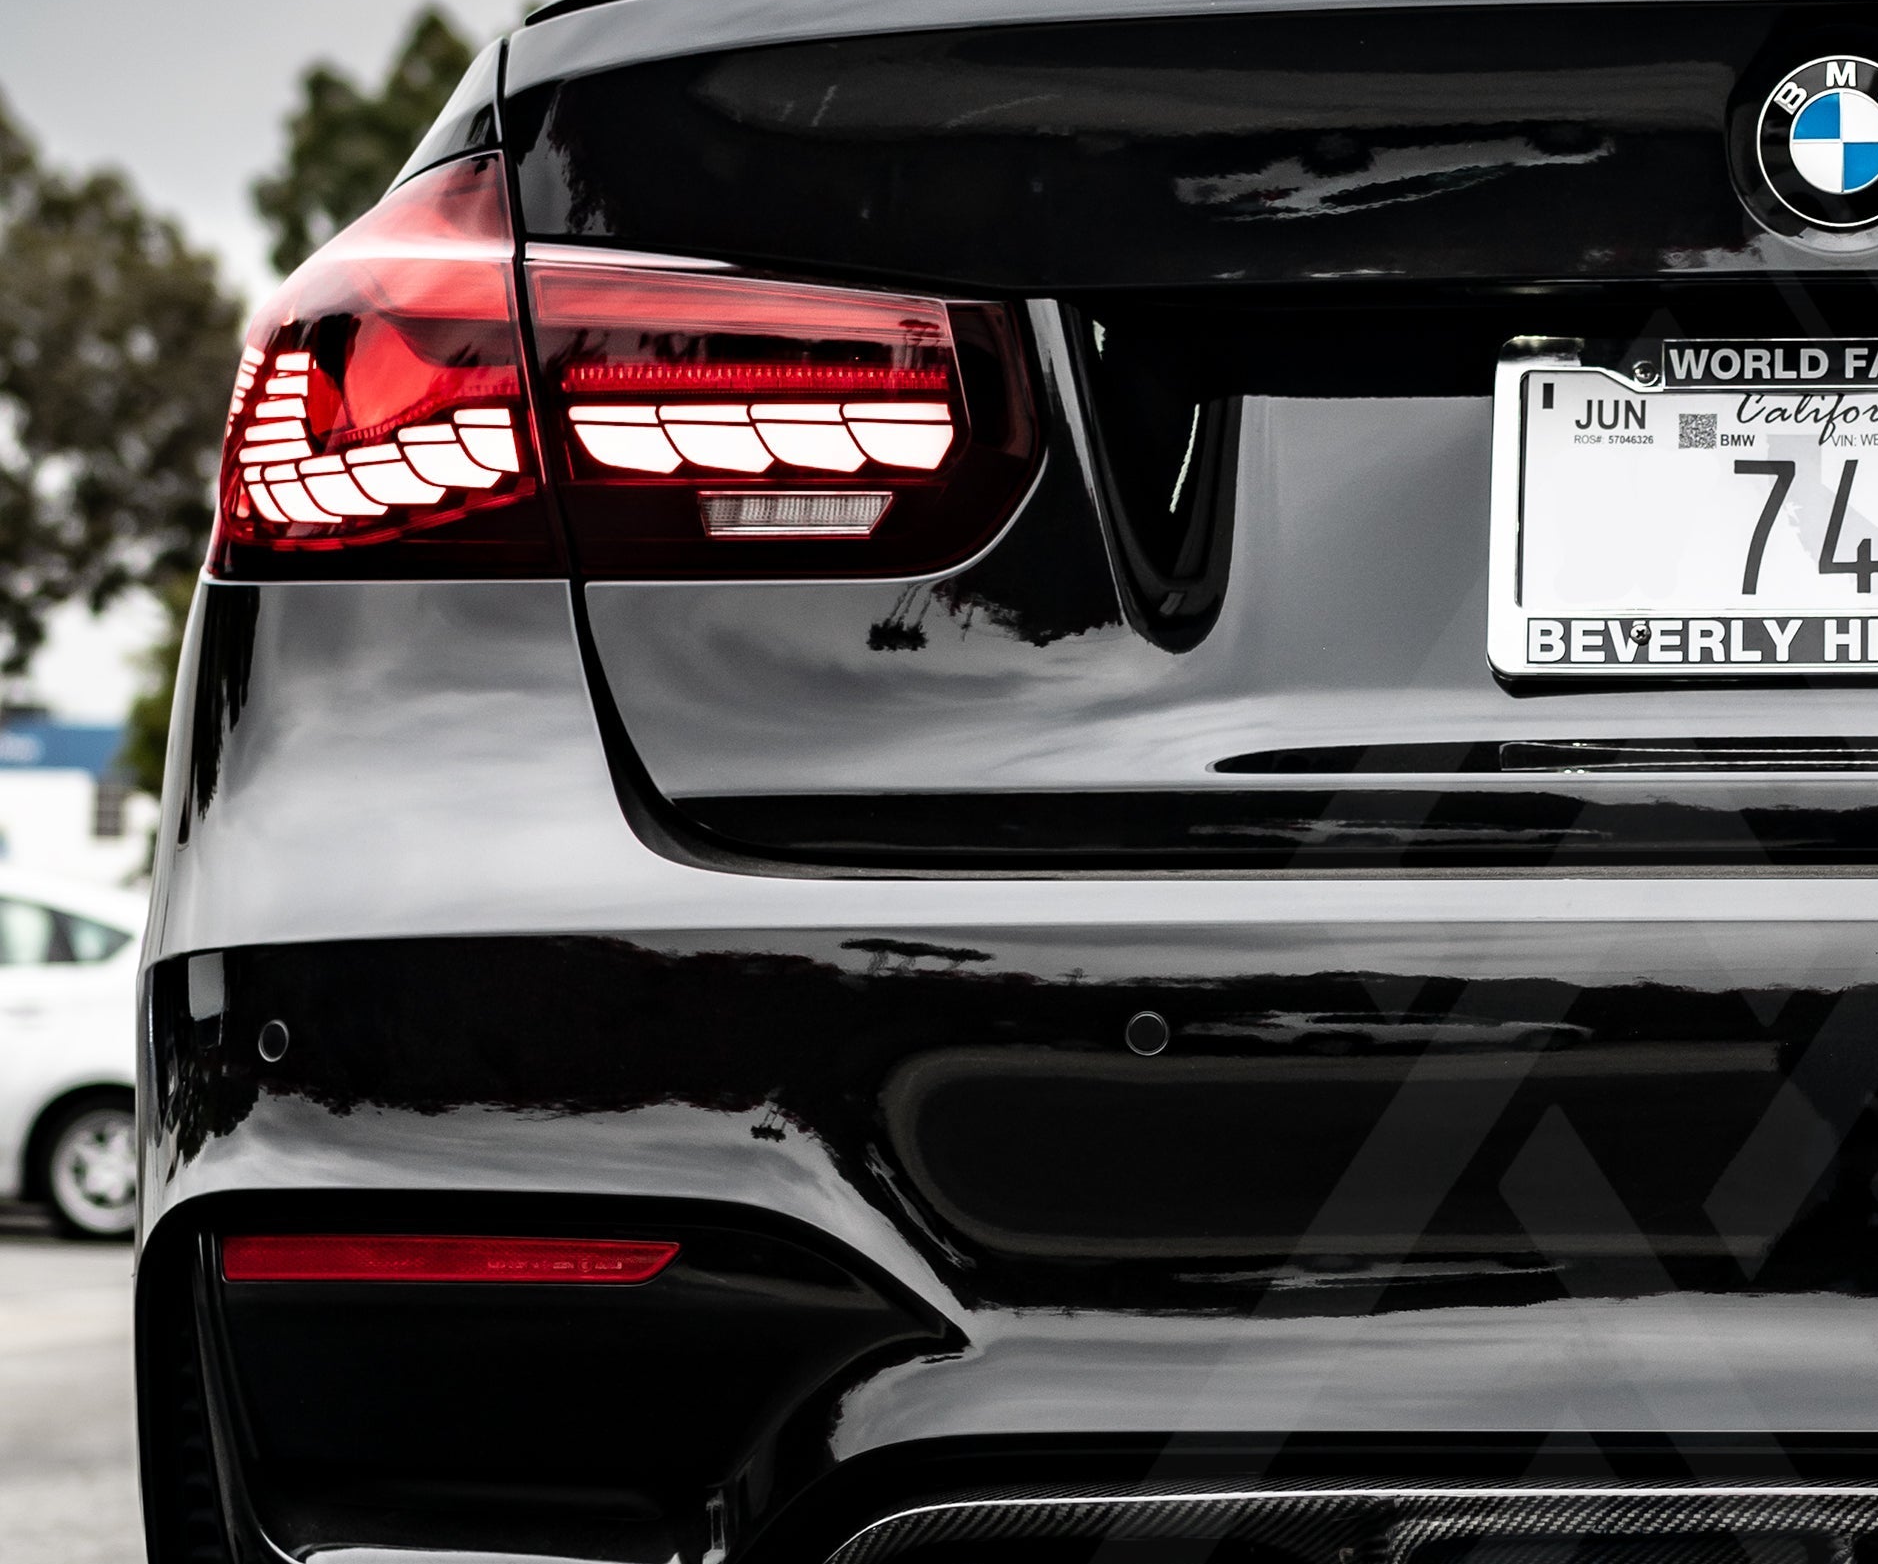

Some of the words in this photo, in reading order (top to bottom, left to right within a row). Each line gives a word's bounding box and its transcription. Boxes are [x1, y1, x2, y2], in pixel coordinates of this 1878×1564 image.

[1669, 348, 1829, 380] WORLD
[1575, 399, 1647, 430] JUN
[1608, 435, 1654, 445] 57046326
[1720, 434, 1756, 447] BMW
[1528, 619, 1804, 663] BEVERLY
